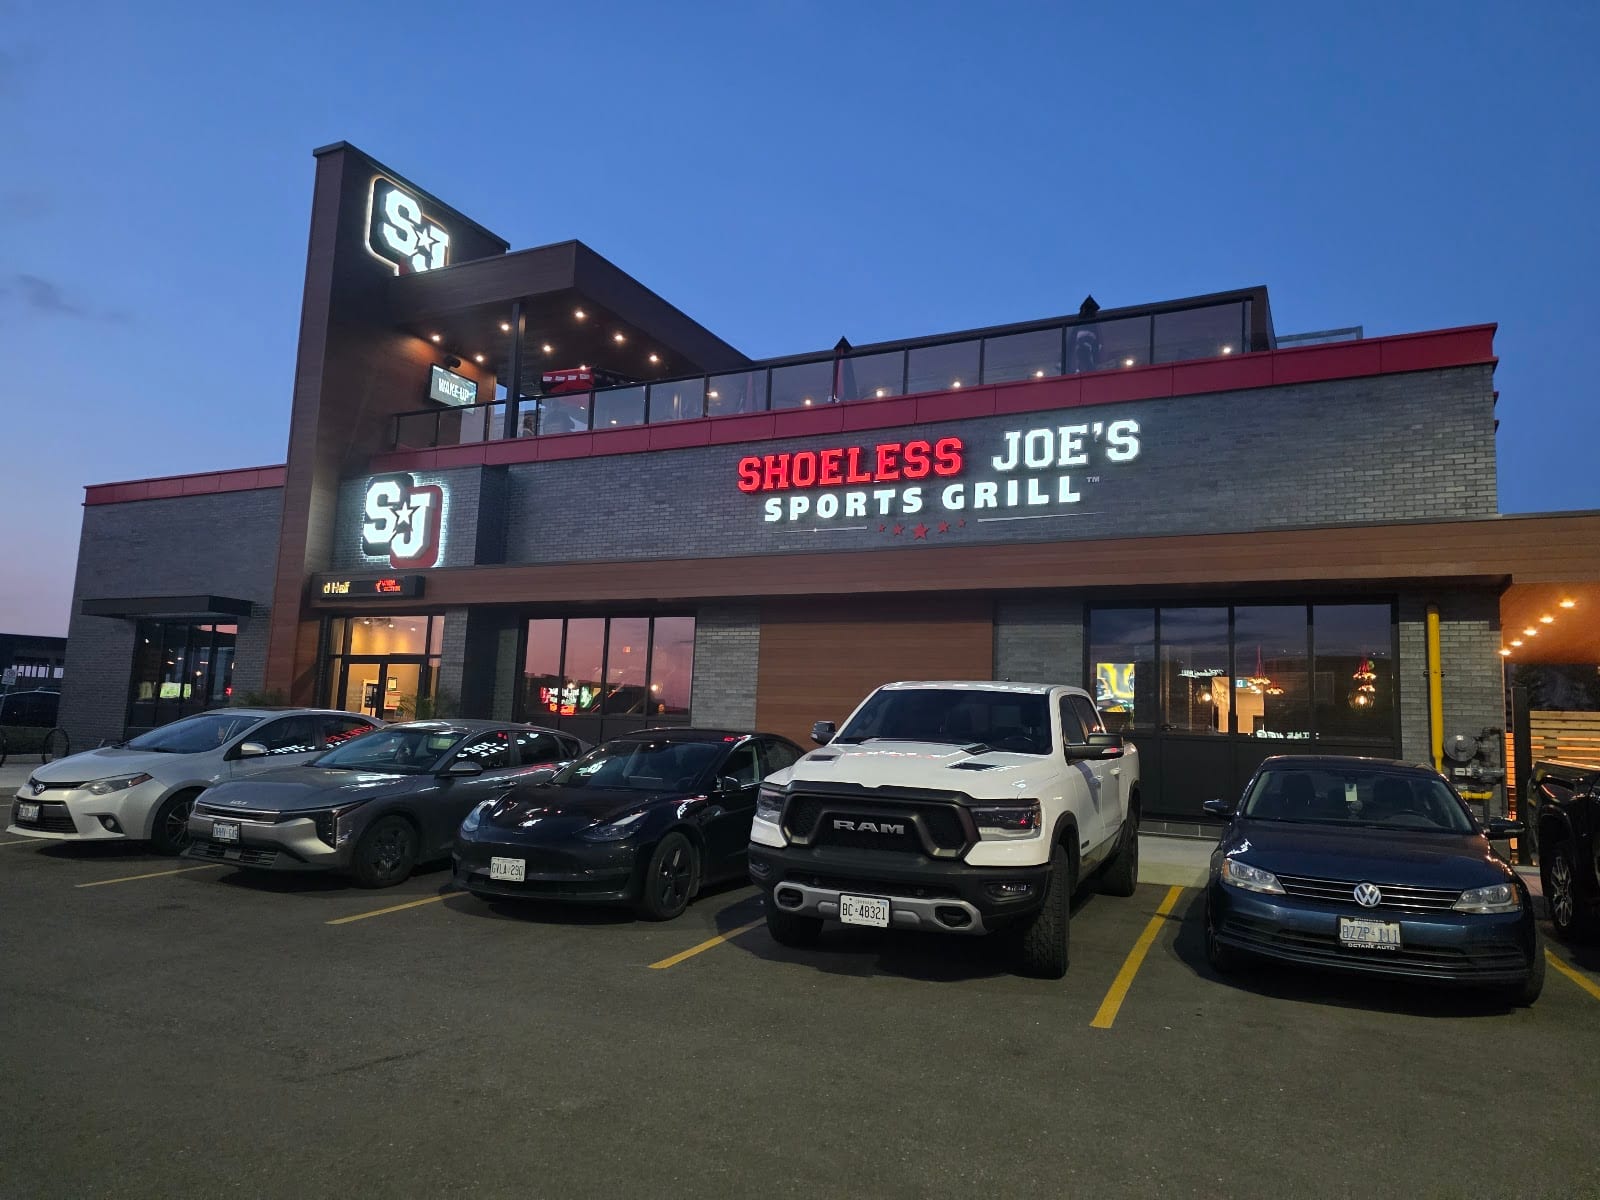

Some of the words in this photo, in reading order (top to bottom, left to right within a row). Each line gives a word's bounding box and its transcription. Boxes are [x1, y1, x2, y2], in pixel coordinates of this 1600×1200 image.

[737, 436, 964, 493] SHOELESS
[991, 419, 1140, 472] JOE'S
[764, 487, 922, 522] SPORTS
[941, 476, 1081, 510] GRILL
[833, 820, 904, 834] RAM
